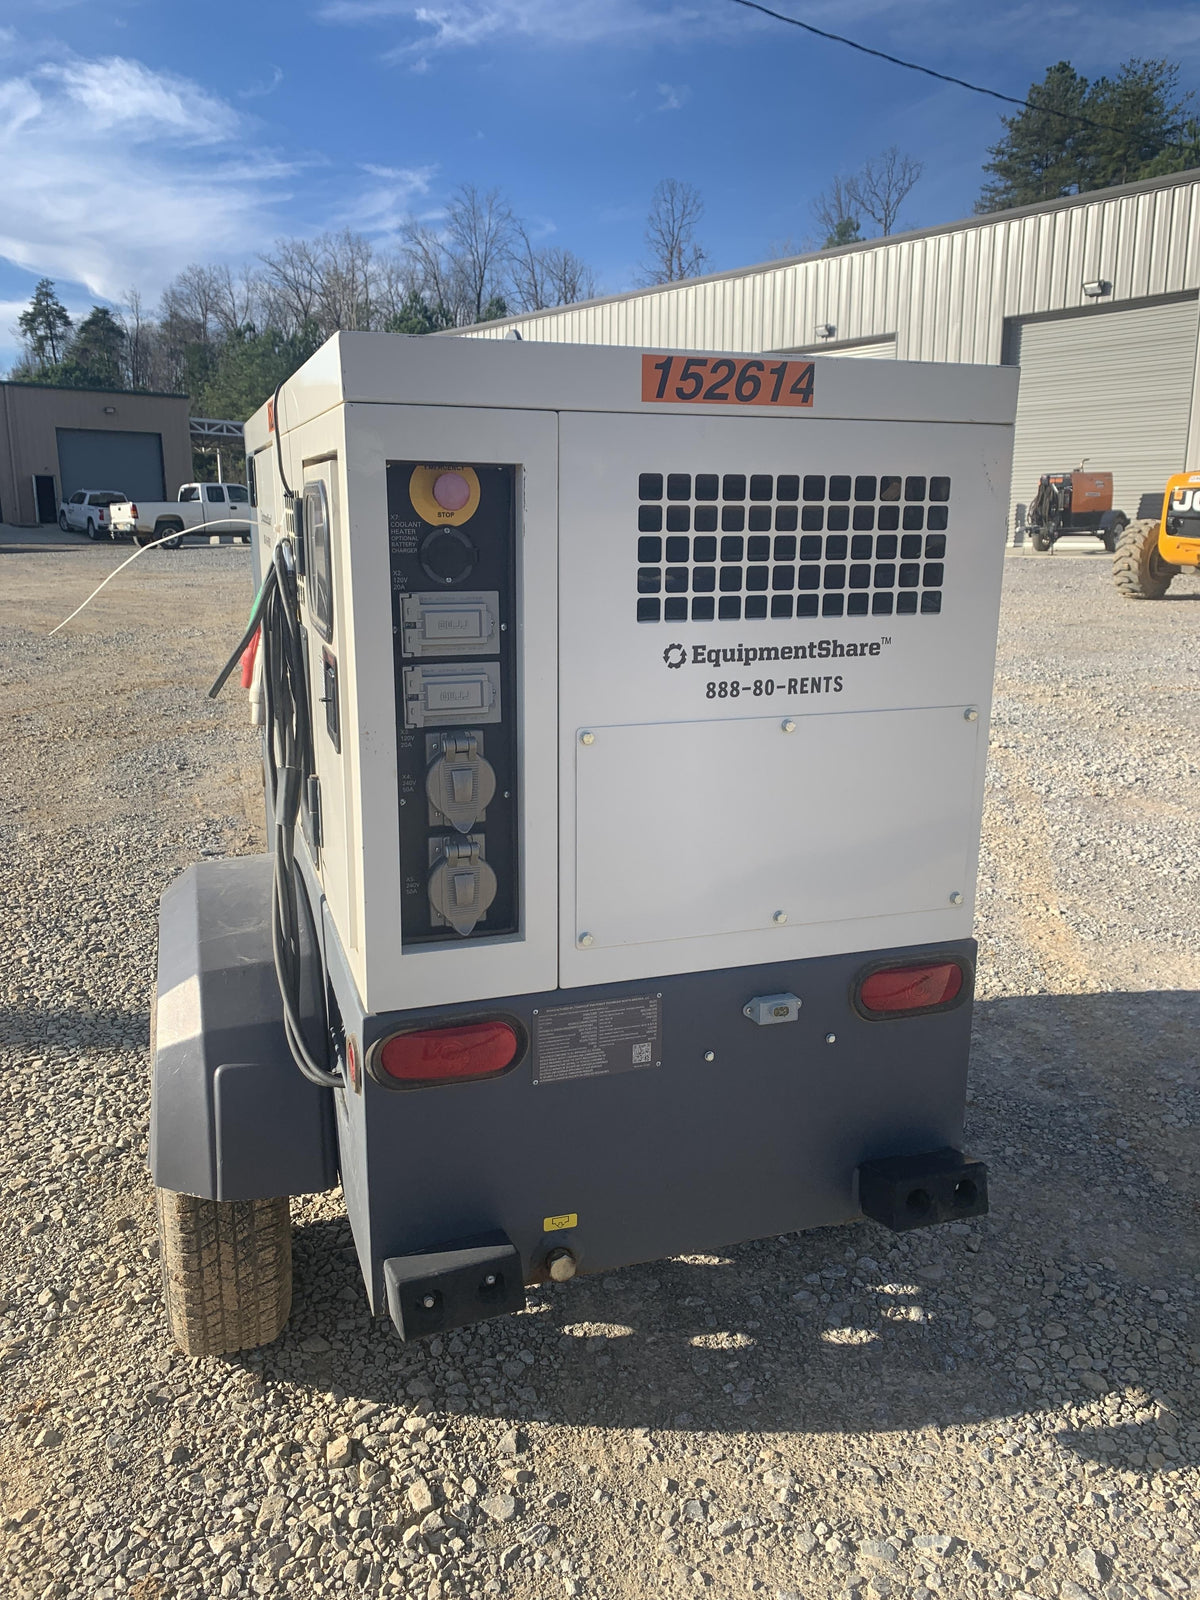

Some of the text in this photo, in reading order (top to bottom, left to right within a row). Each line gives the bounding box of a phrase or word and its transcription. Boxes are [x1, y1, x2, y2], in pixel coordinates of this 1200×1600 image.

[654, 355, 815, 403] 152614
[691, 639, 881, 667] EquipmentShare
[706, 675, 844, 699] 888-80-RENTS
